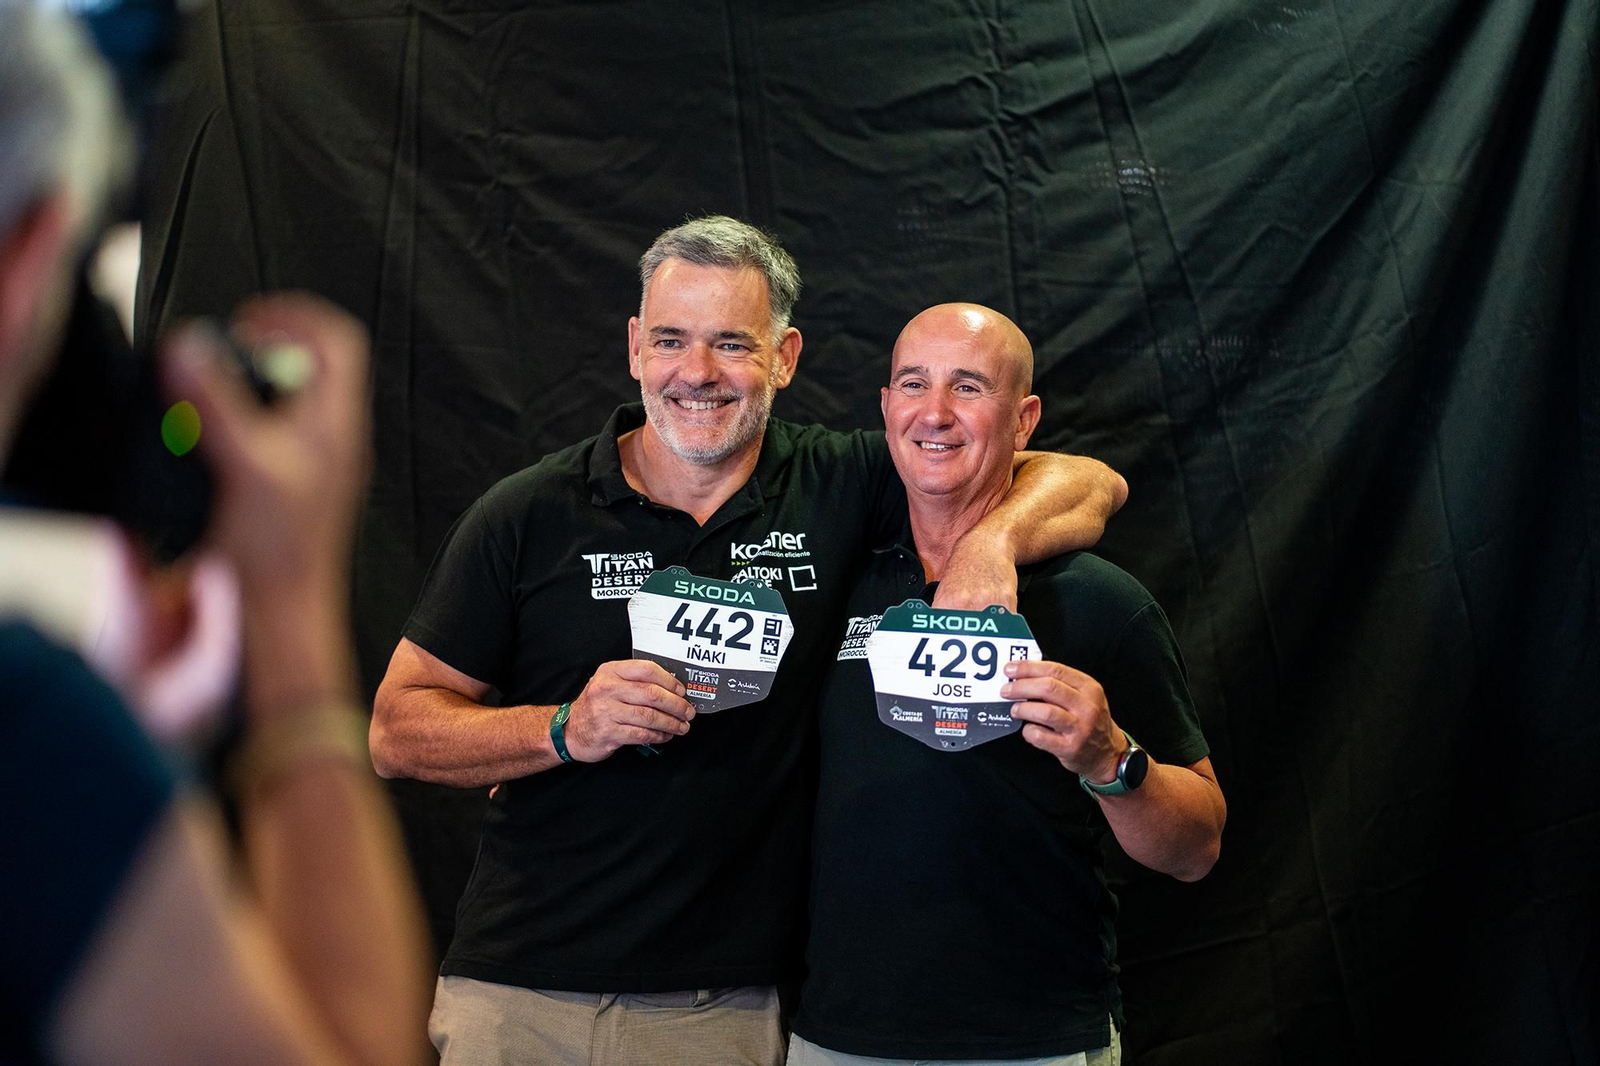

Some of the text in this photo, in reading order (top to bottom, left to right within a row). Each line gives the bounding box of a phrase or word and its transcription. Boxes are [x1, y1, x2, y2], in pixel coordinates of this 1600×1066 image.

[581, 553, 654, 574] TITAN
[733, 566, 783, 581] ALTOKI
[596, 588, 639, 597] MOROC
[666, 602, 755, 651] 442
[840, 637, 868, 649] DESER
[686, 644, 726, 664] IÑAKI
[908, 637, 998, 681] 429
[685, 667, 719, 685] TITAN
[687, 682, 718, 693] DESERT
[933, 684, 972, 698] JOSE
[931, 705, 968, 720] TITAN
[935, 721, 968, 729] DESERT
